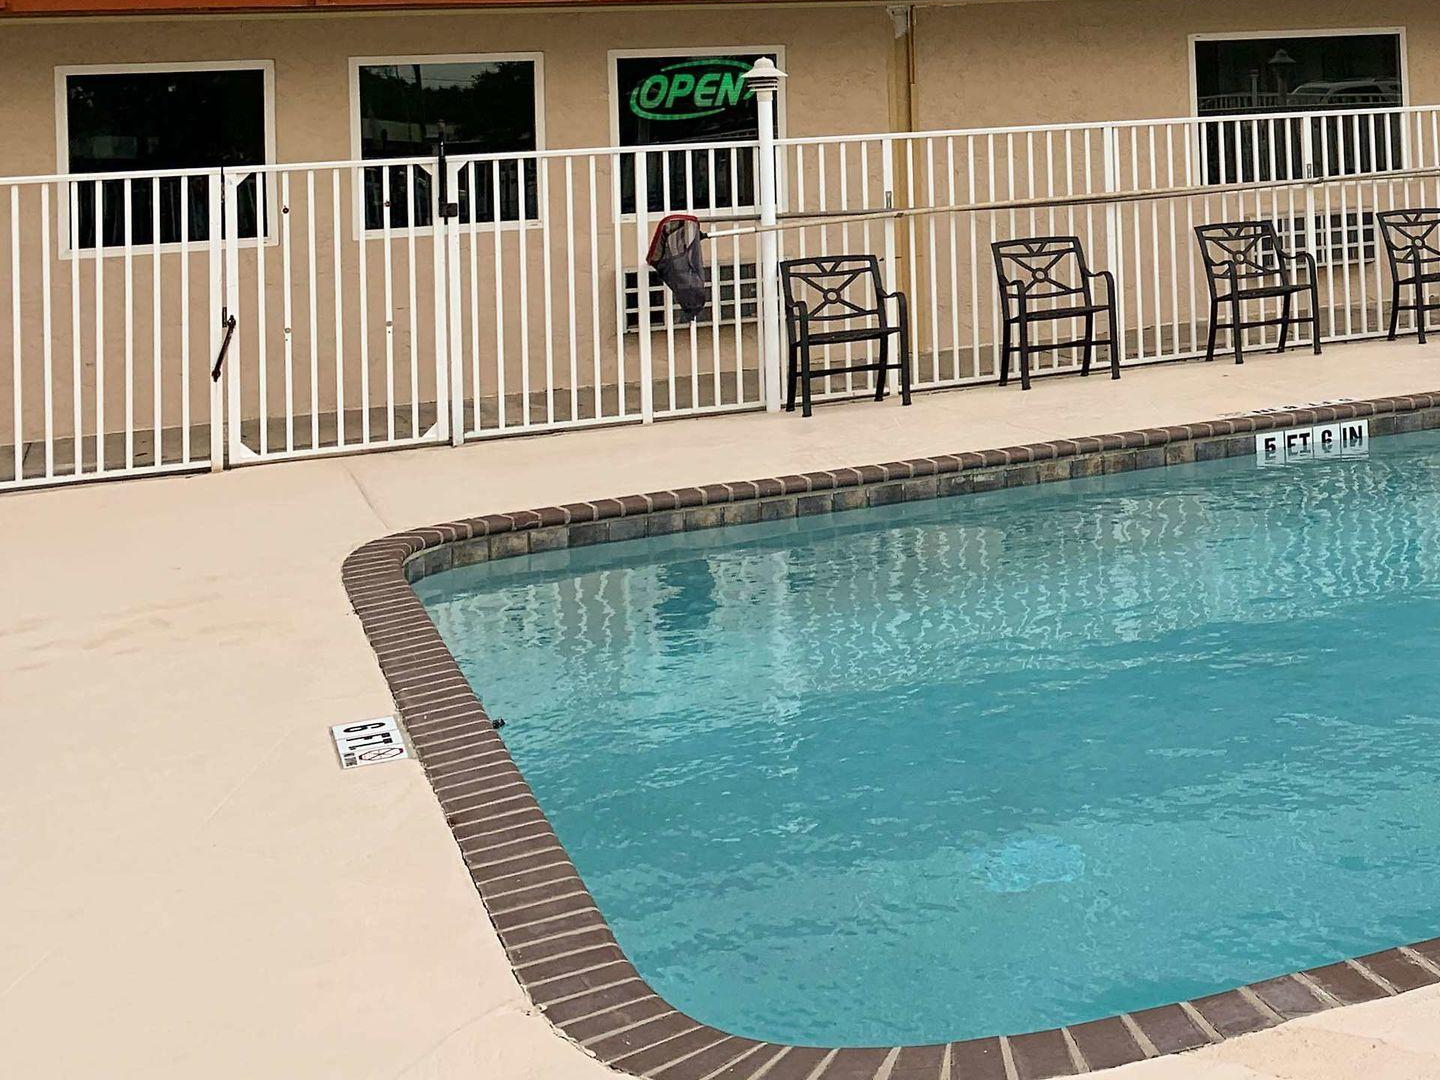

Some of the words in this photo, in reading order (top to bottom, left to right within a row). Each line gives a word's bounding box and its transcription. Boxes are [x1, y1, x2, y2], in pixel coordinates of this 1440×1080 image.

[639, 72, 745, 109] OPEN
[1286, 432, 1311, 451] FT
[1342, 425, 1363, 444] IN
[343, 722, 386, 733] 6
